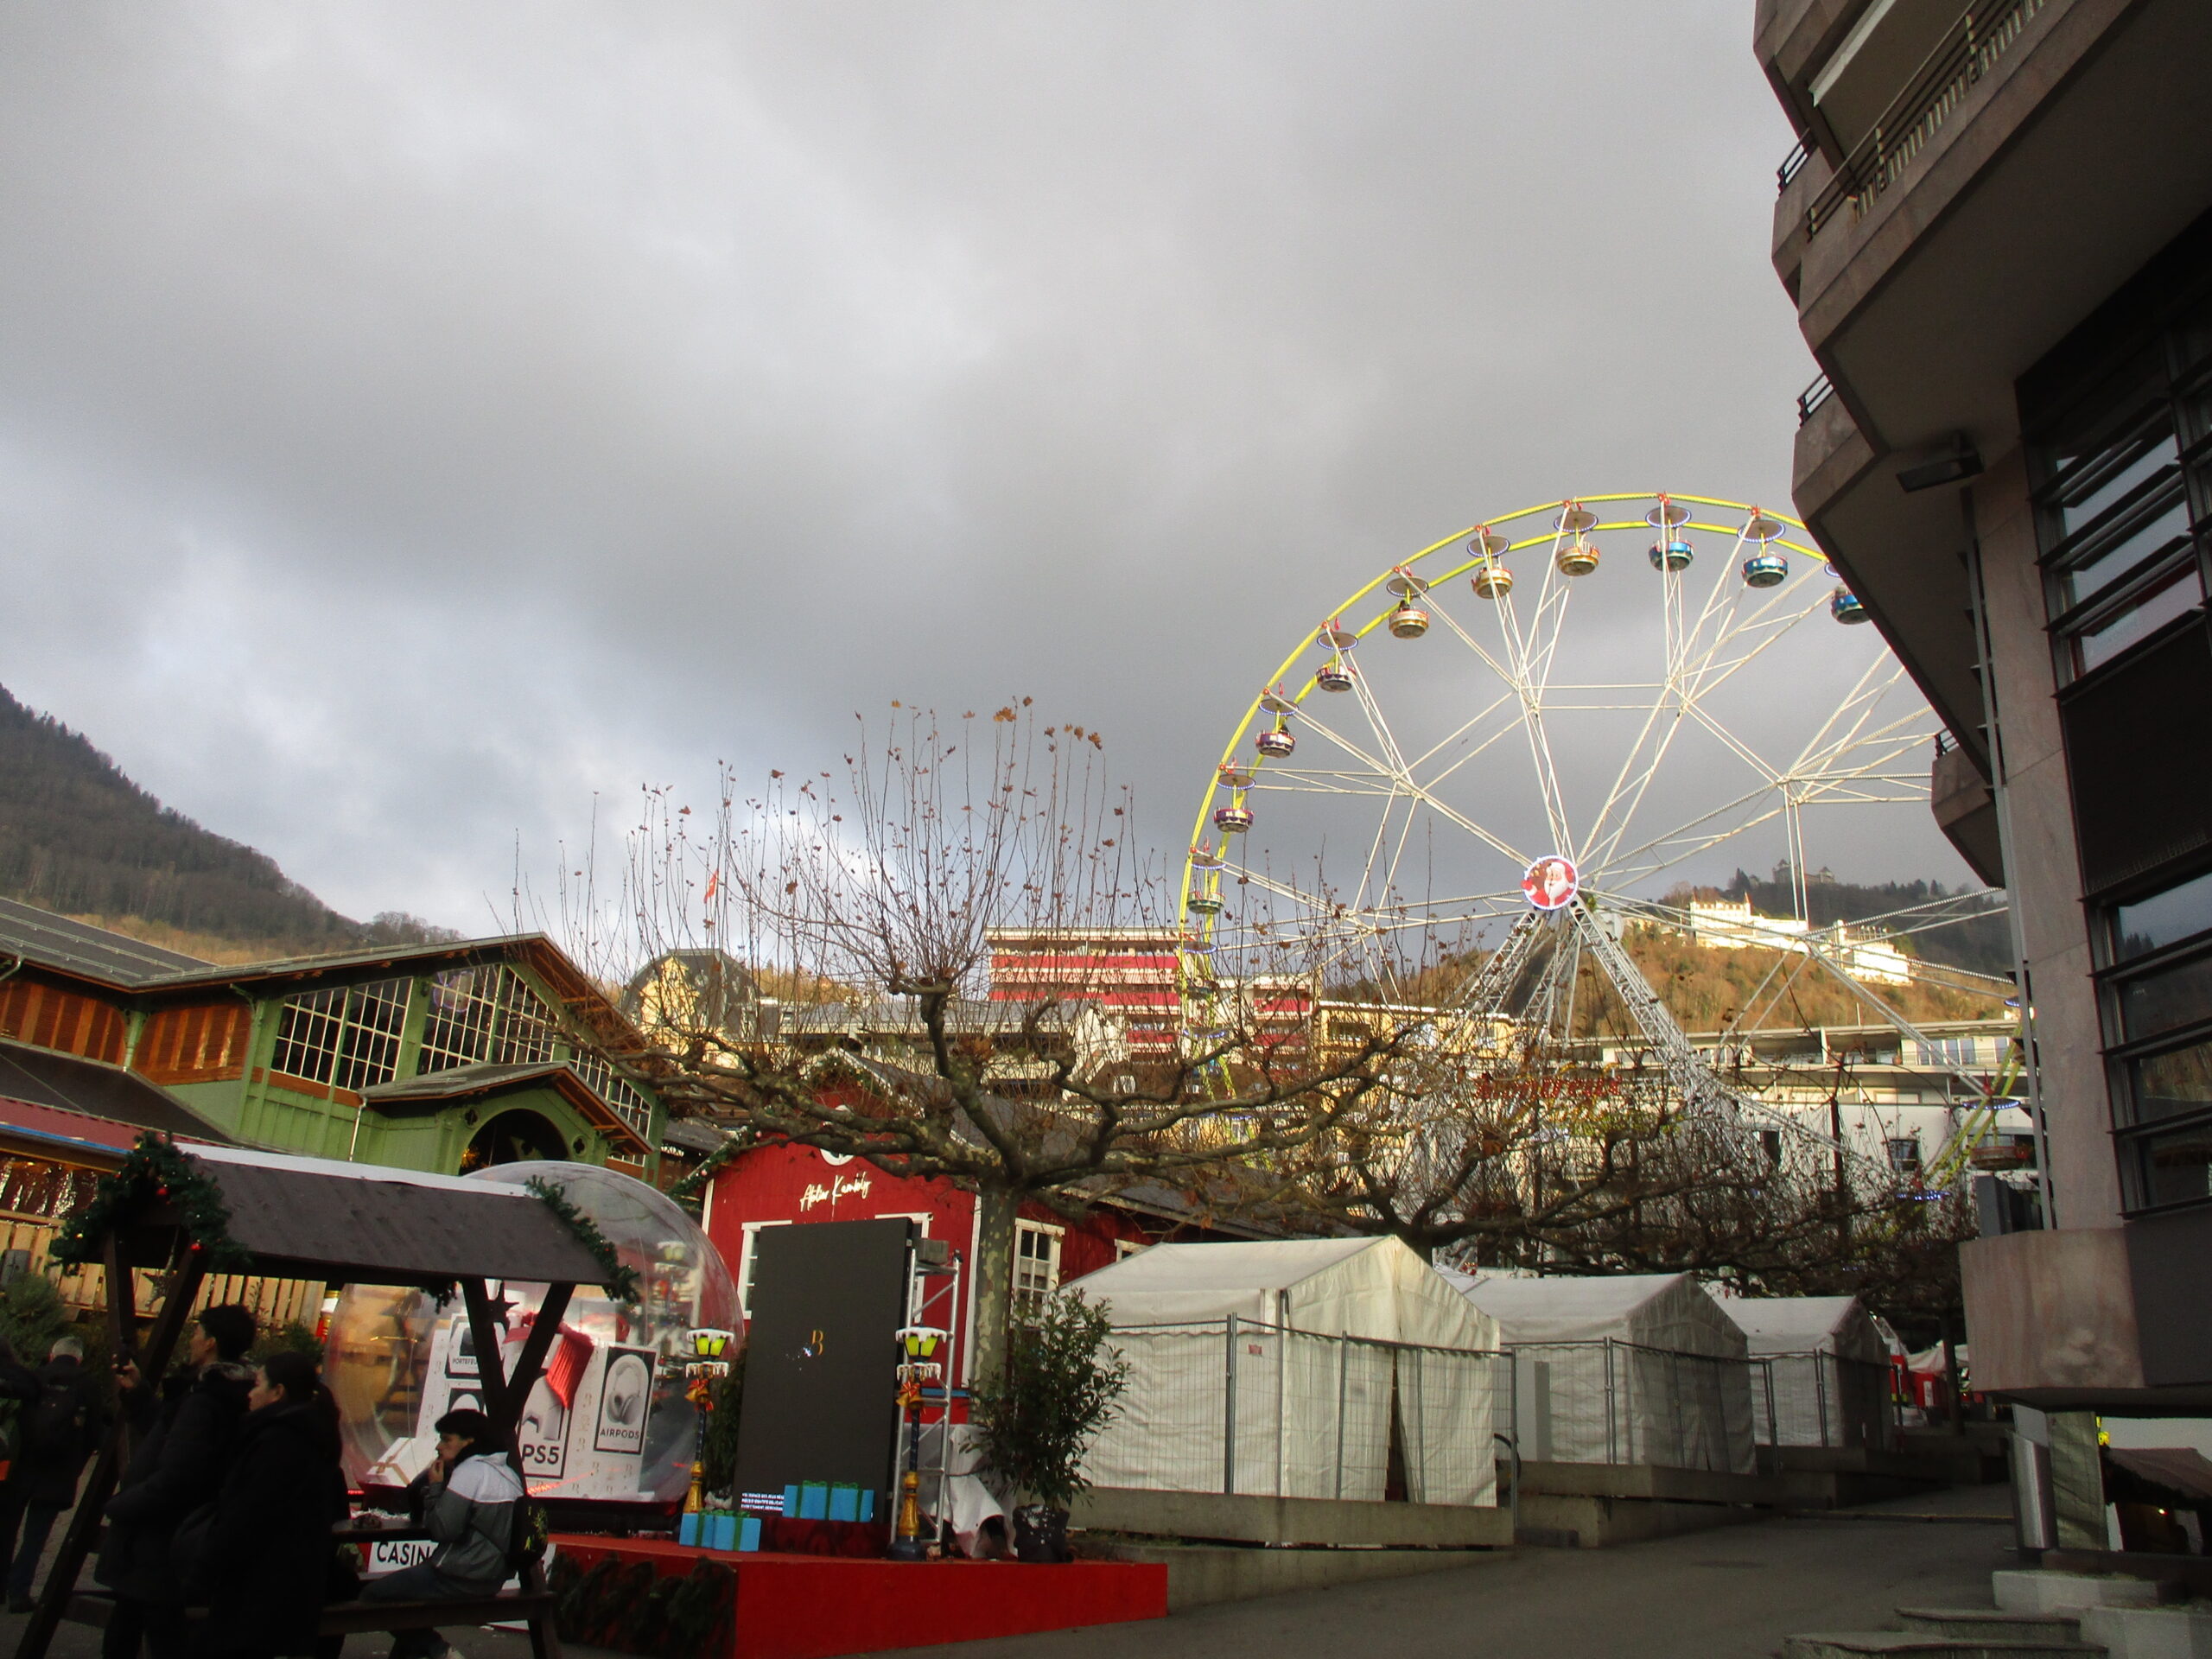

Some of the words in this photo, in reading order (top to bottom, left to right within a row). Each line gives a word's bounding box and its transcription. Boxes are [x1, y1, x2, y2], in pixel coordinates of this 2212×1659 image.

[600, 1428, 639, 1440] AIRPODS
[521, 1444, 560, 1465] PS5
[377, 1541, 430, 1567] CASIN
